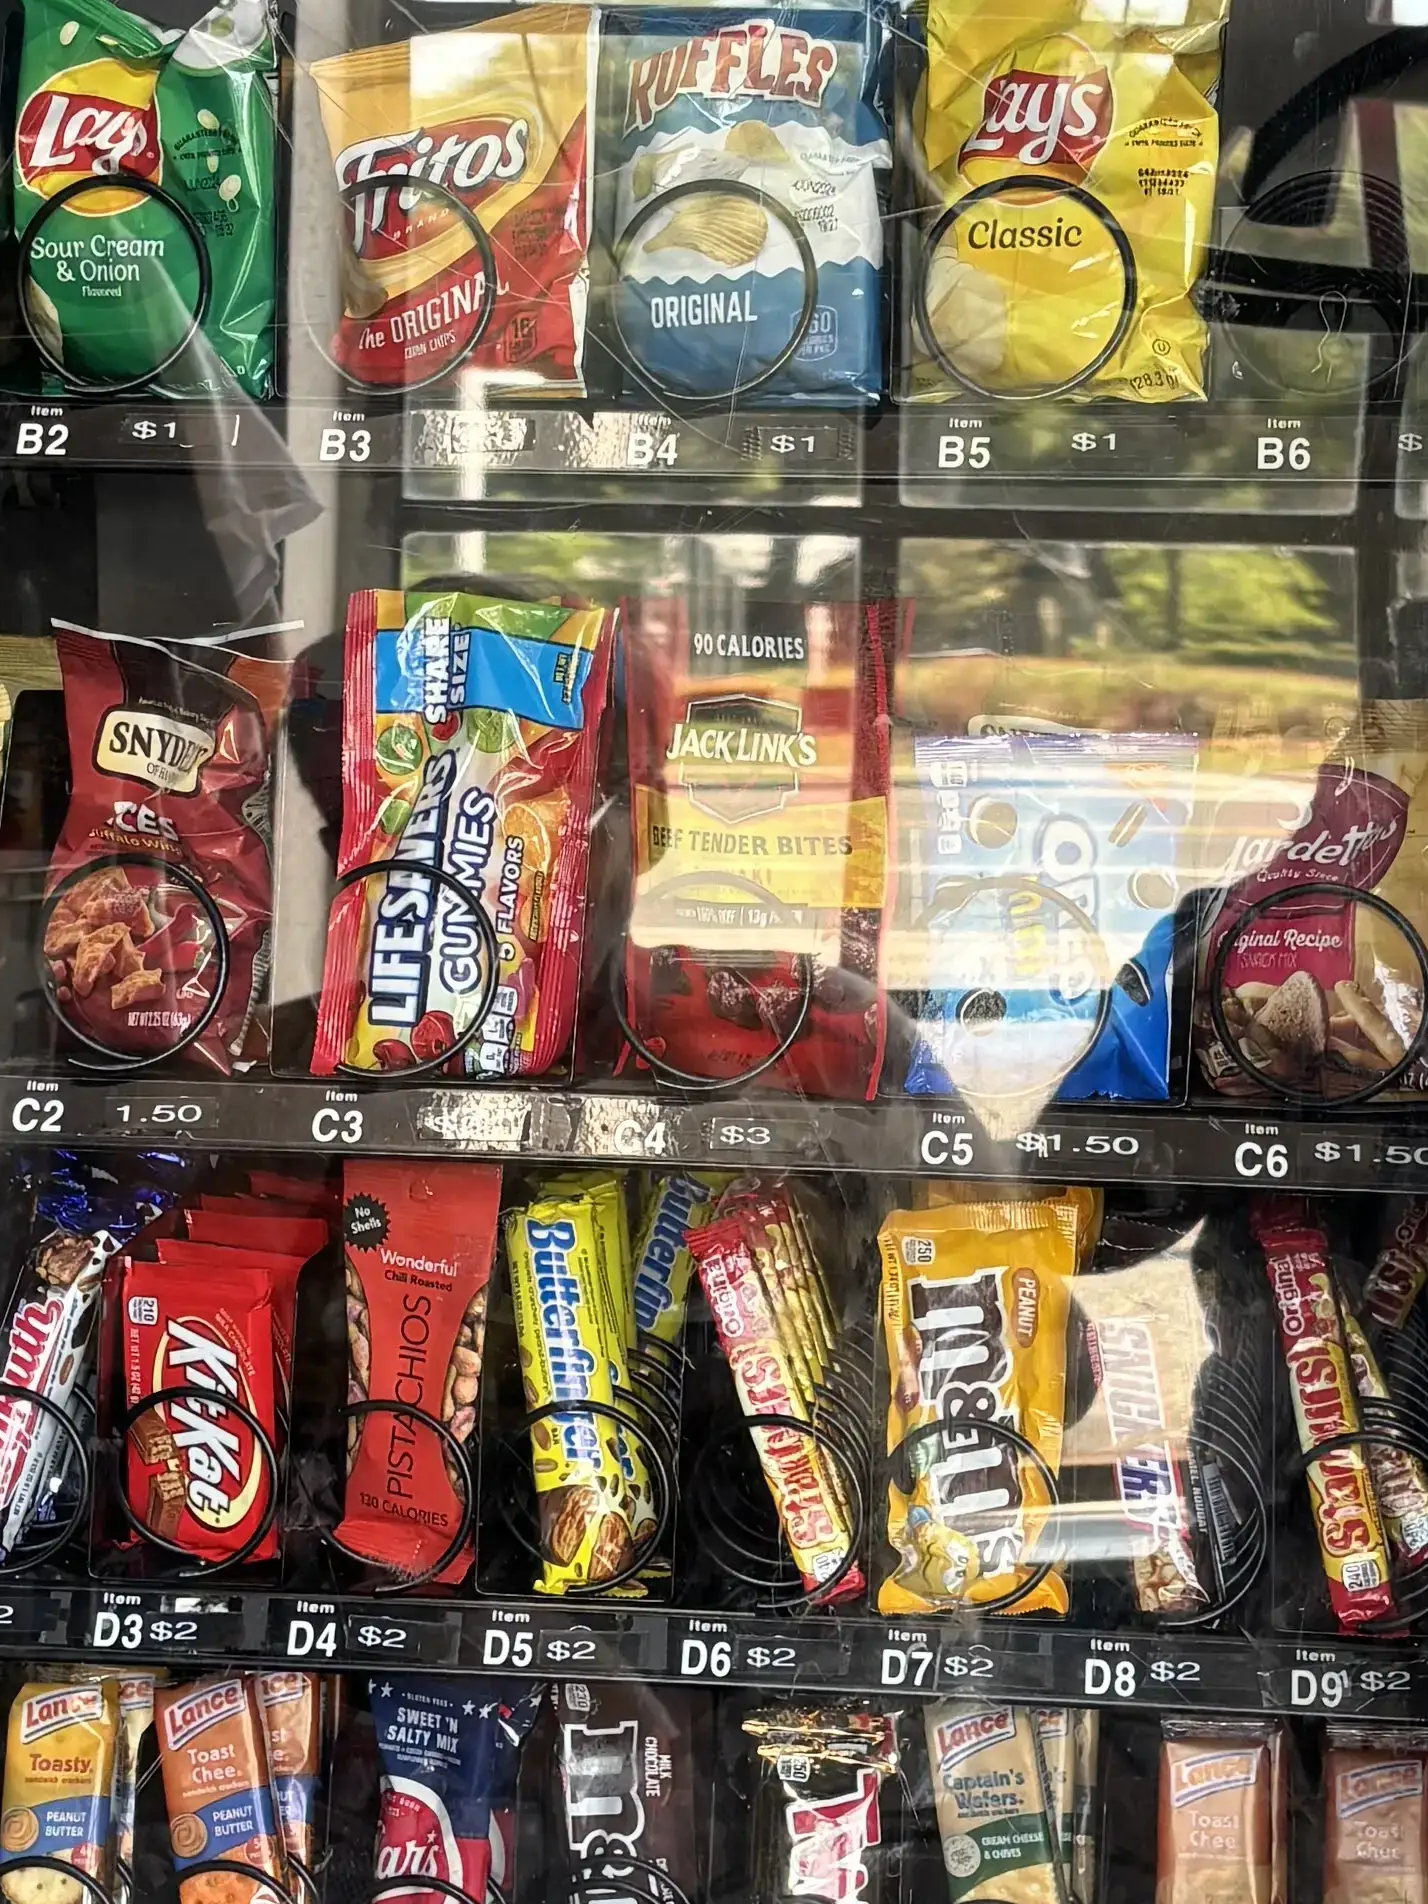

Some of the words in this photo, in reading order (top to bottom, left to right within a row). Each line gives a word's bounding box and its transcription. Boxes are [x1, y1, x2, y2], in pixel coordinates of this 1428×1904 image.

[623, 24, 836, 134] RUFFLES
[335, 117, 530, 255] Fritos
[31, 237, 85, 259] Sour
[90, 234, 165, 259] Cream
[968, 217, 1083, 250] Classic
[56, 260, 76, 282] &
[79, 259, 140, 282] Onion
[651, 290, 758, 329] ORIGINAL
[16, 423, 69, 455] B2
[131, 419, 176, 439] $1
[319, 429, 371, 462] B3
[627, 433, 679, 465] B4
[937, 436, 991, 470] B5
[1071, 432, 1118, 452] $1
[1256, 438, 1311, 471] B6
[693, 632, 713, 656] 90
[717, 633, 806, 661] CALORIES
[423, 616, 451, 726] SHARE
[450, 626, 470, 702] SIZE
[666, 723, 734, 760] JACK
[737, 726, 818, 767] LINK'S
[688, 828, 769, 857] TENDER
[775, 833, 853, 857] BITES
[497, 834, 525, 936] FLAVORS
[1283, 928, 1343, 953] Recipe
[12, 1099, 66, 1133] C2
[116, 1103, 203, 1125] 1.50
[311, 1110, 363, 1144] C3
[613, 1121, 668, 1155] C4
[720, 1124, 772, 1147] $3
[920, 1130, 974, 1167] C5
[1234, 1141, 1289, 1178] C6
[350, 1215, 382, 1234] Shells
[355, 1206, 371, 1219] No
[380, 1248, 459, 1278] Wonderful
[384, 1270, 408, 1283] Chili
[411, 1274, 453, 1292] Roasted
[142, 1299, 156, 1323] 210
[1015, 1276, 1036, 1339] PEANUT
[386, 1294, 432, 1500] PISTACHIOS
[92, 1611, 143, 1648] D3
[149, 1620, 198, 1641] $2
[286, 1620, 337, 1657] D4
[483, 1629, 534, 1668] D5
[546, 1641, 597, 1660] $2
[681, 1638, 732, 1678] D6
[880, 1648, 934, 1686] D7
[1083, 1658, 1137, 1696] D8
[1290, 1669, 1342, 1707] D9
[167, 1686, 240, 1739] Lance
[397, 1706, 442, 1729] SWEET
[187, 1744, 236, 1764] Toast
[386, 1724, 431, 1746] SALTY
[436, 1732, 460, 1755] MIX
[645, 1736, 659, 1798] CHOCOLATE
[943, 1769, 1025, 1791] Captain's
[212, 1804, 253, 1823] PEANUT
[214, 1818, 254, 1838] BUTTER
